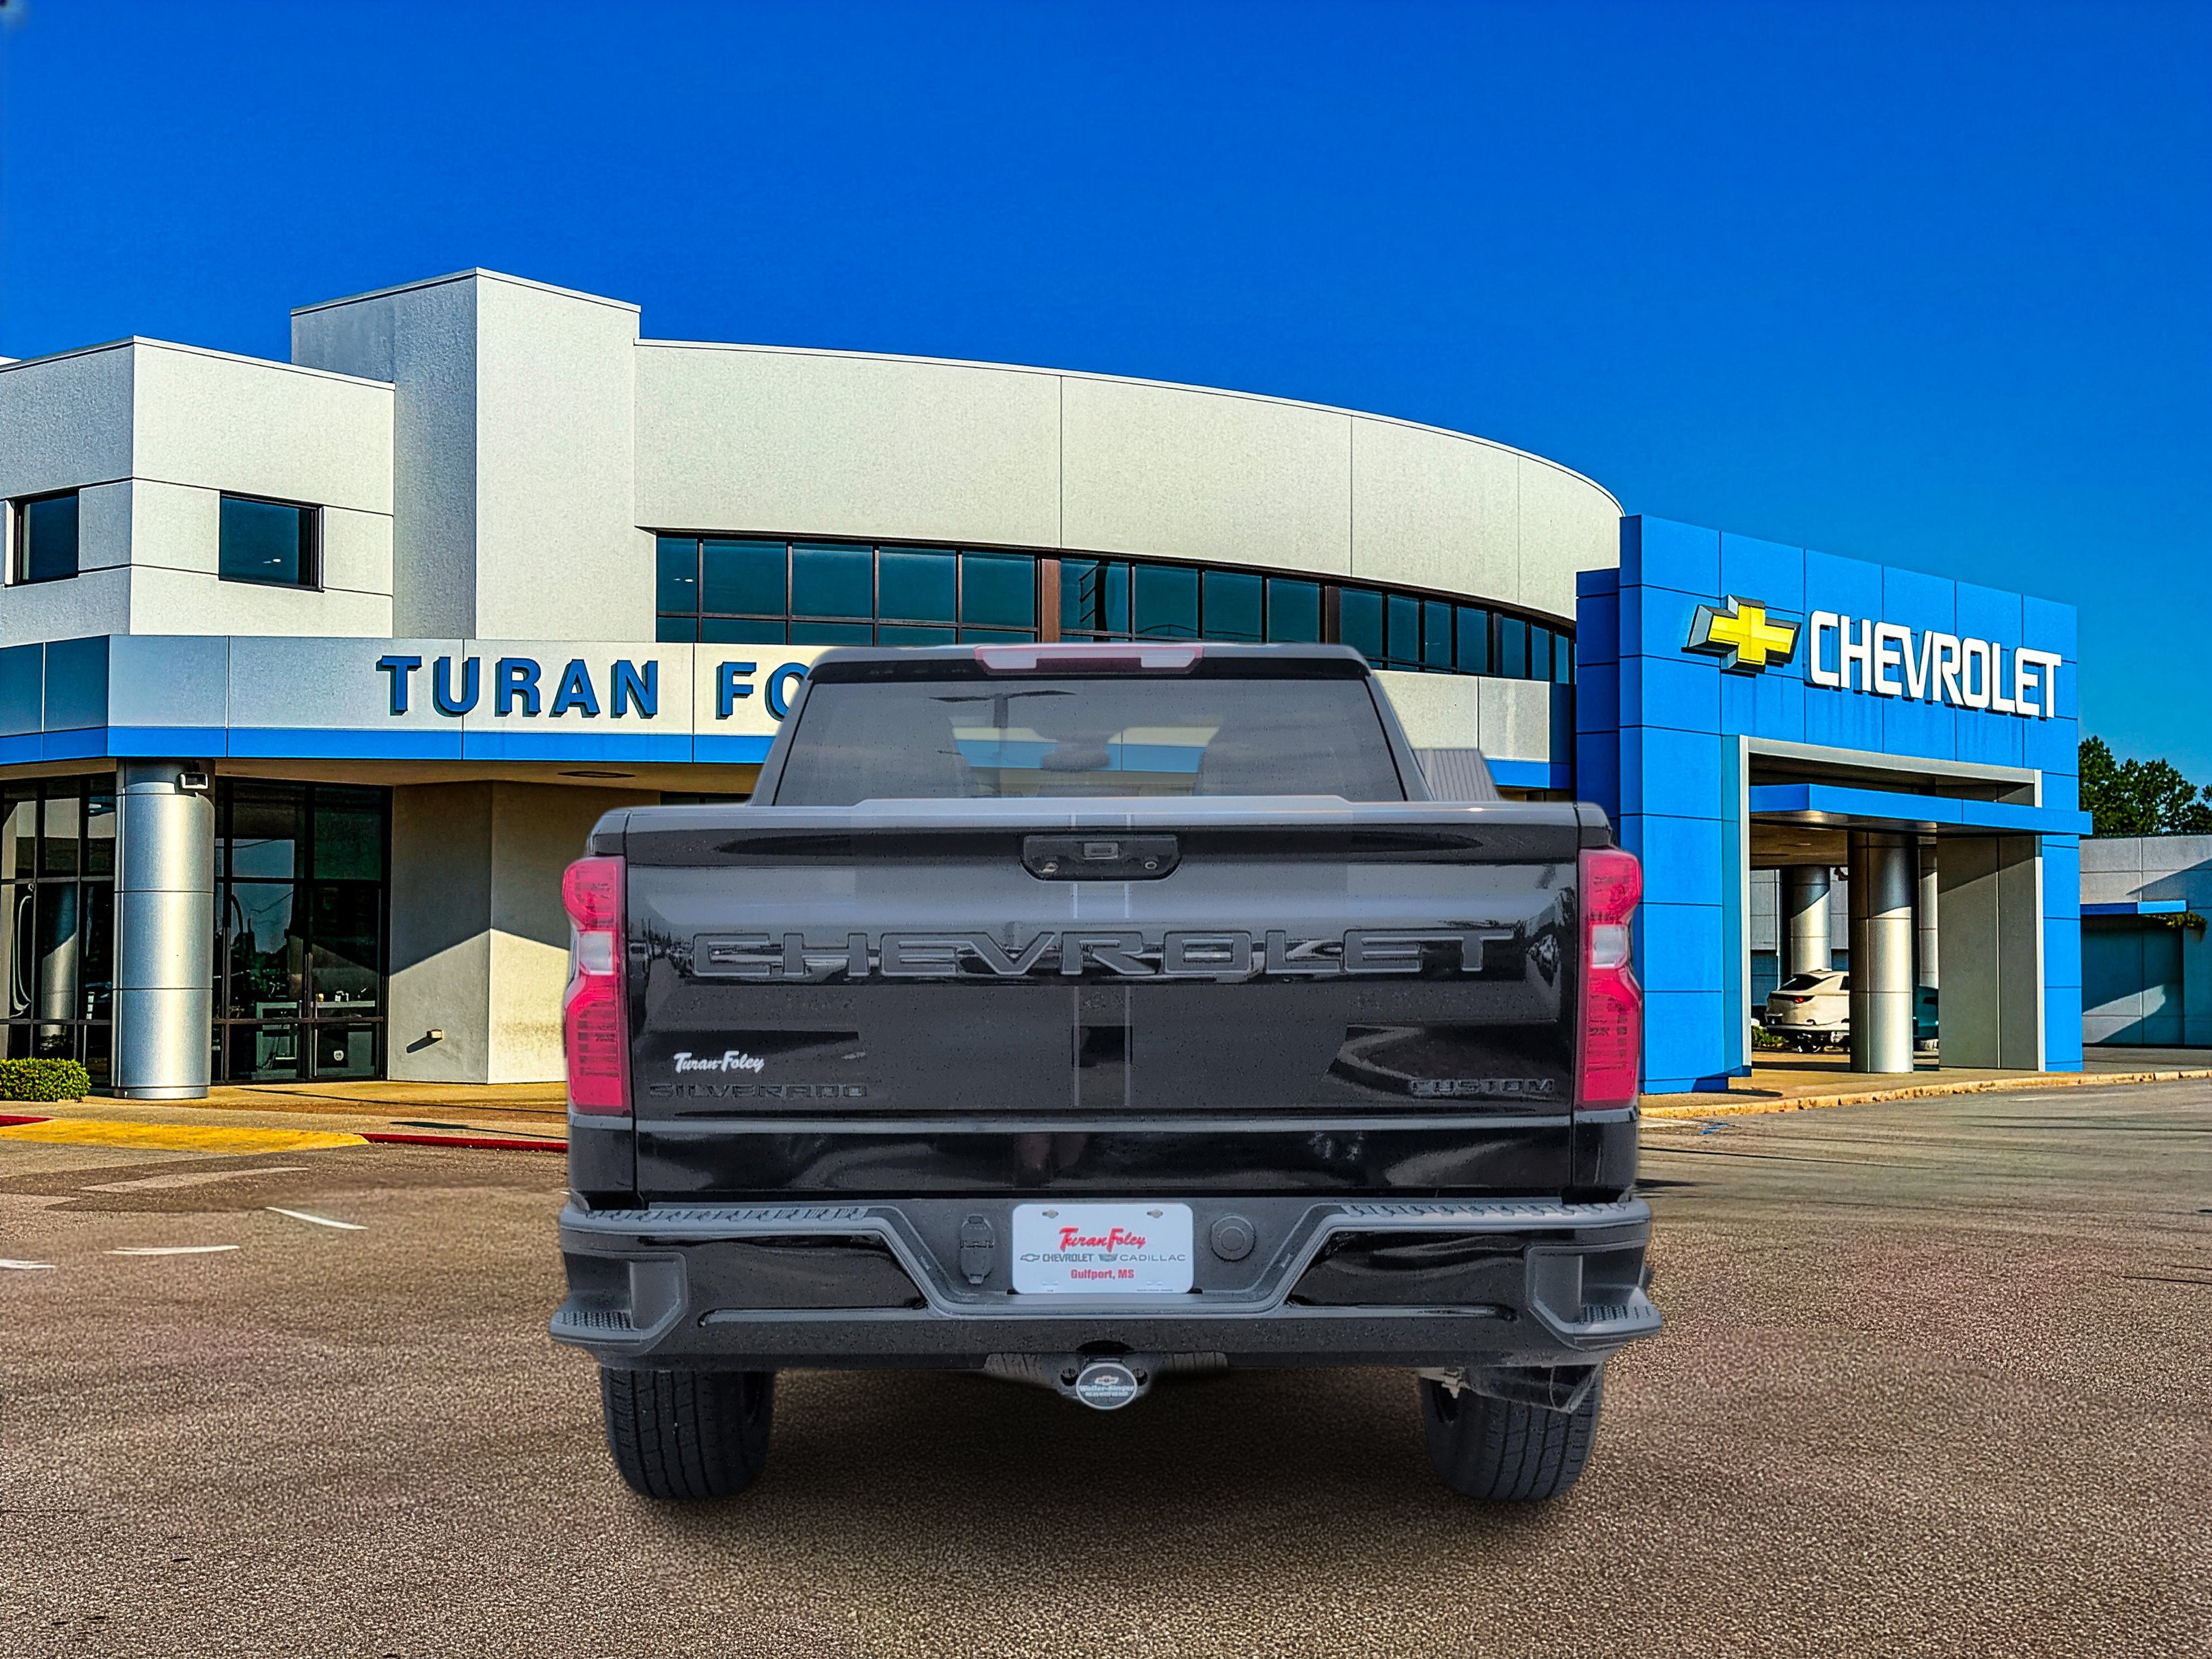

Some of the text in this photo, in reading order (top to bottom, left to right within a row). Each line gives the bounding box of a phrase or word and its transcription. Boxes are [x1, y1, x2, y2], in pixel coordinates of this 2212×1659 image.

[1808, 610, 2062, 719] CHEVROLET
[376, 655, 658, 719] TURAN
[693, 928, 1514, 976] CHEVROLET
[650, 1083, 867, 1098] SILVERADO
[1042, 1253, 1186, 1263] CHEVROLET CADILLAC
[1070, 1269, 1135, 1280] Gulfport, MS
